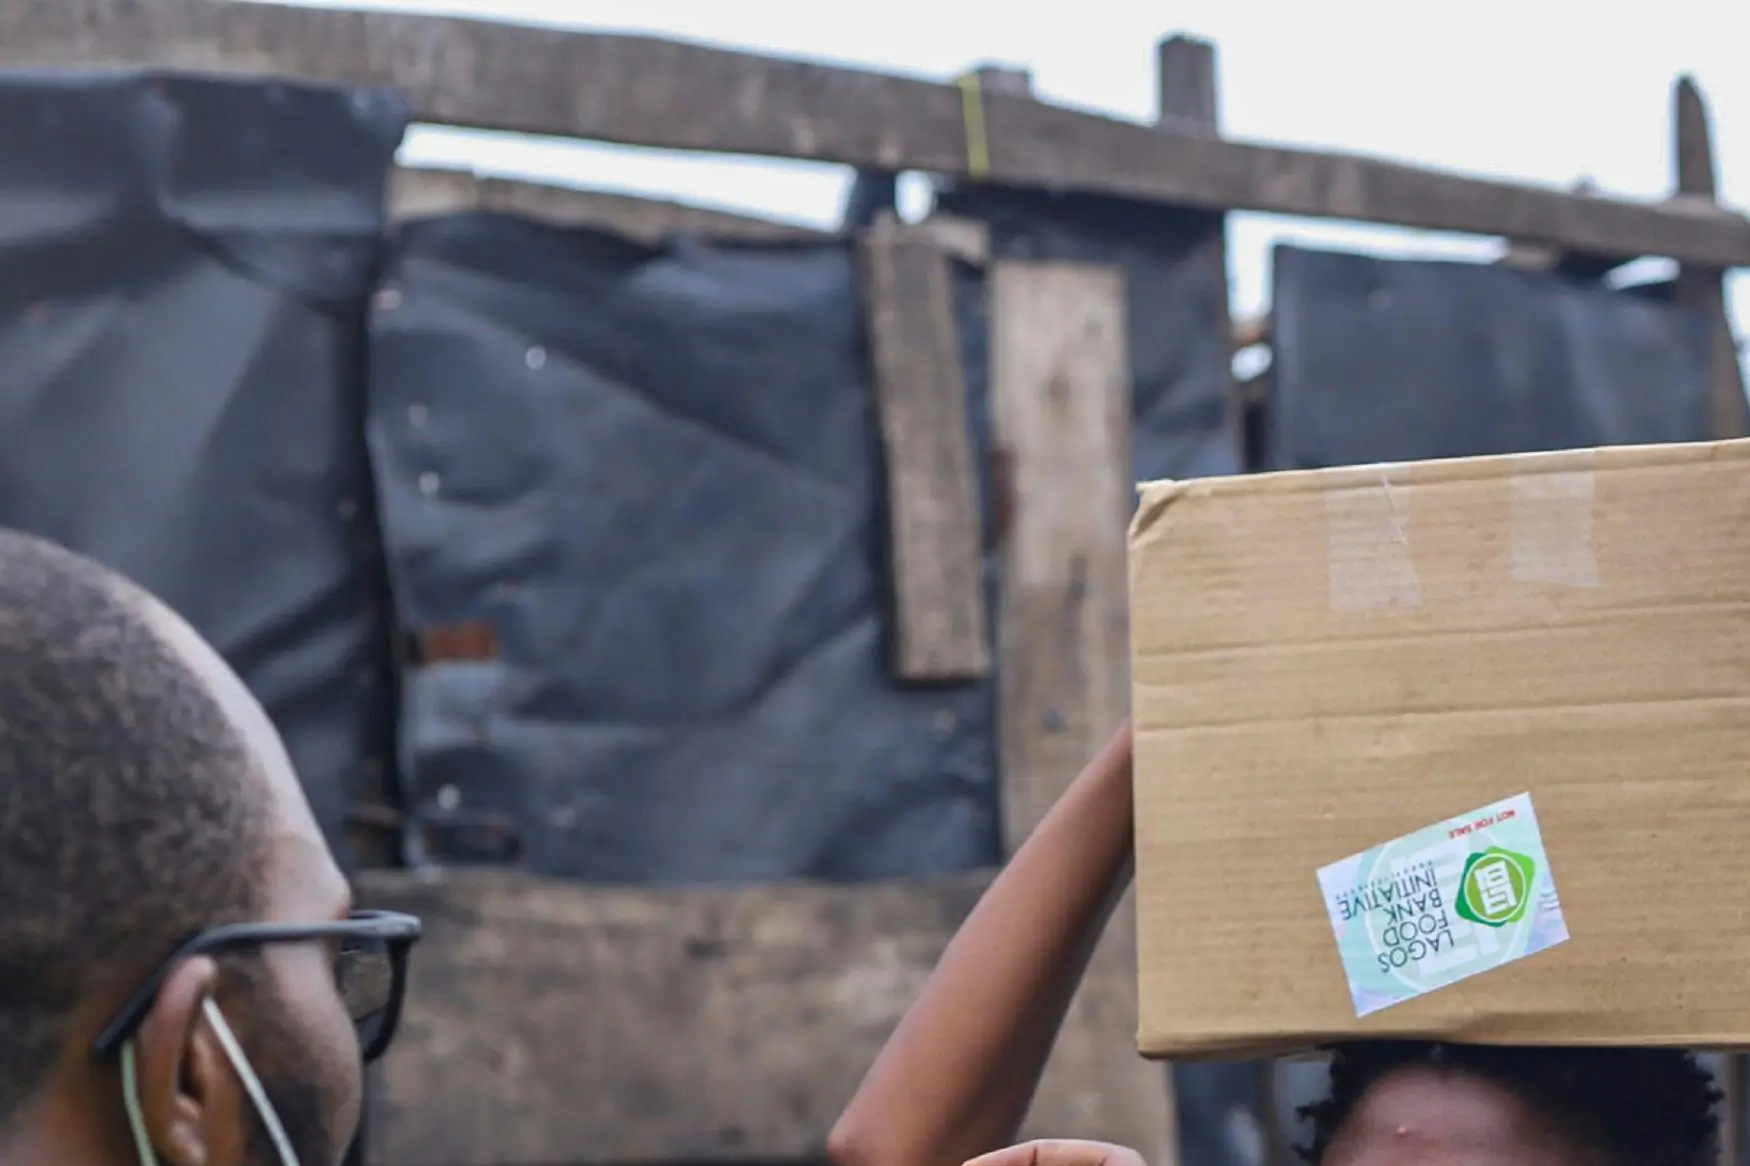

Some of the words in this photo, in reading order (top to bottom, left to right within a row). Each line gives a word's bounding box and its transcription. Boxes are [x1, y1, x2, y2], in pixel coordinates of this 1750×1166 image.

[1448, 823, 1472, 839] SALE
[1474, 817, 1495, 831] FOR
[1496, 809, 1516, 822] NOT
[1338, 867, 1438, 921] INITIATIVE
[1382, 888, 1442, 926] BANK
[1383, 909, 1449, 947] FOOD
[1378, 929, 1455, 974] LAGOS
